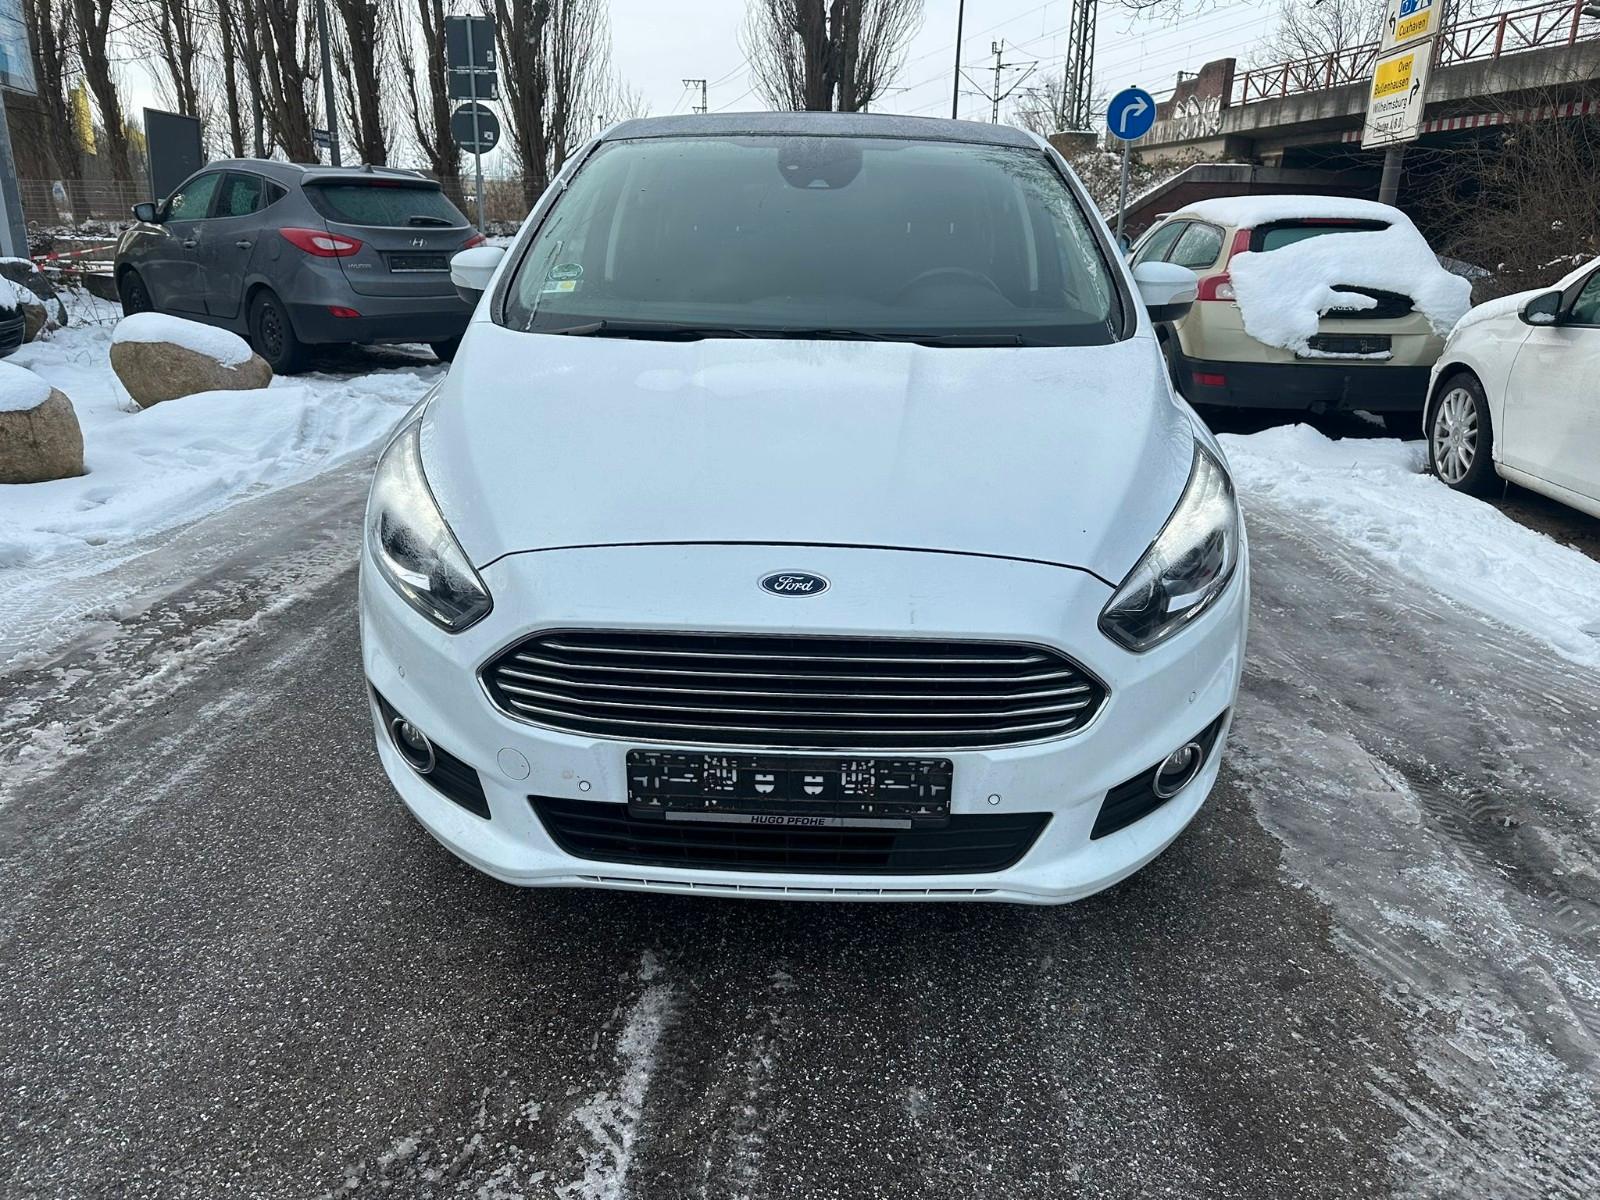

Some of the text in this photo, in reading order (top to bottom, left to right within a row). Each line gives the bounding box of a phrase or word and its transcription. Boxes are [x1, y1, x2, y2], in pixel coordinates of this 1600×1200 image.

[1398, 18, 1426, 36] Cuxhaven
[1373, 97, 1408, 114] Wilhelmsburg
[774, 575, 815, 591] Ford
[751, 815, 826, 826] HUGO PFOHE
